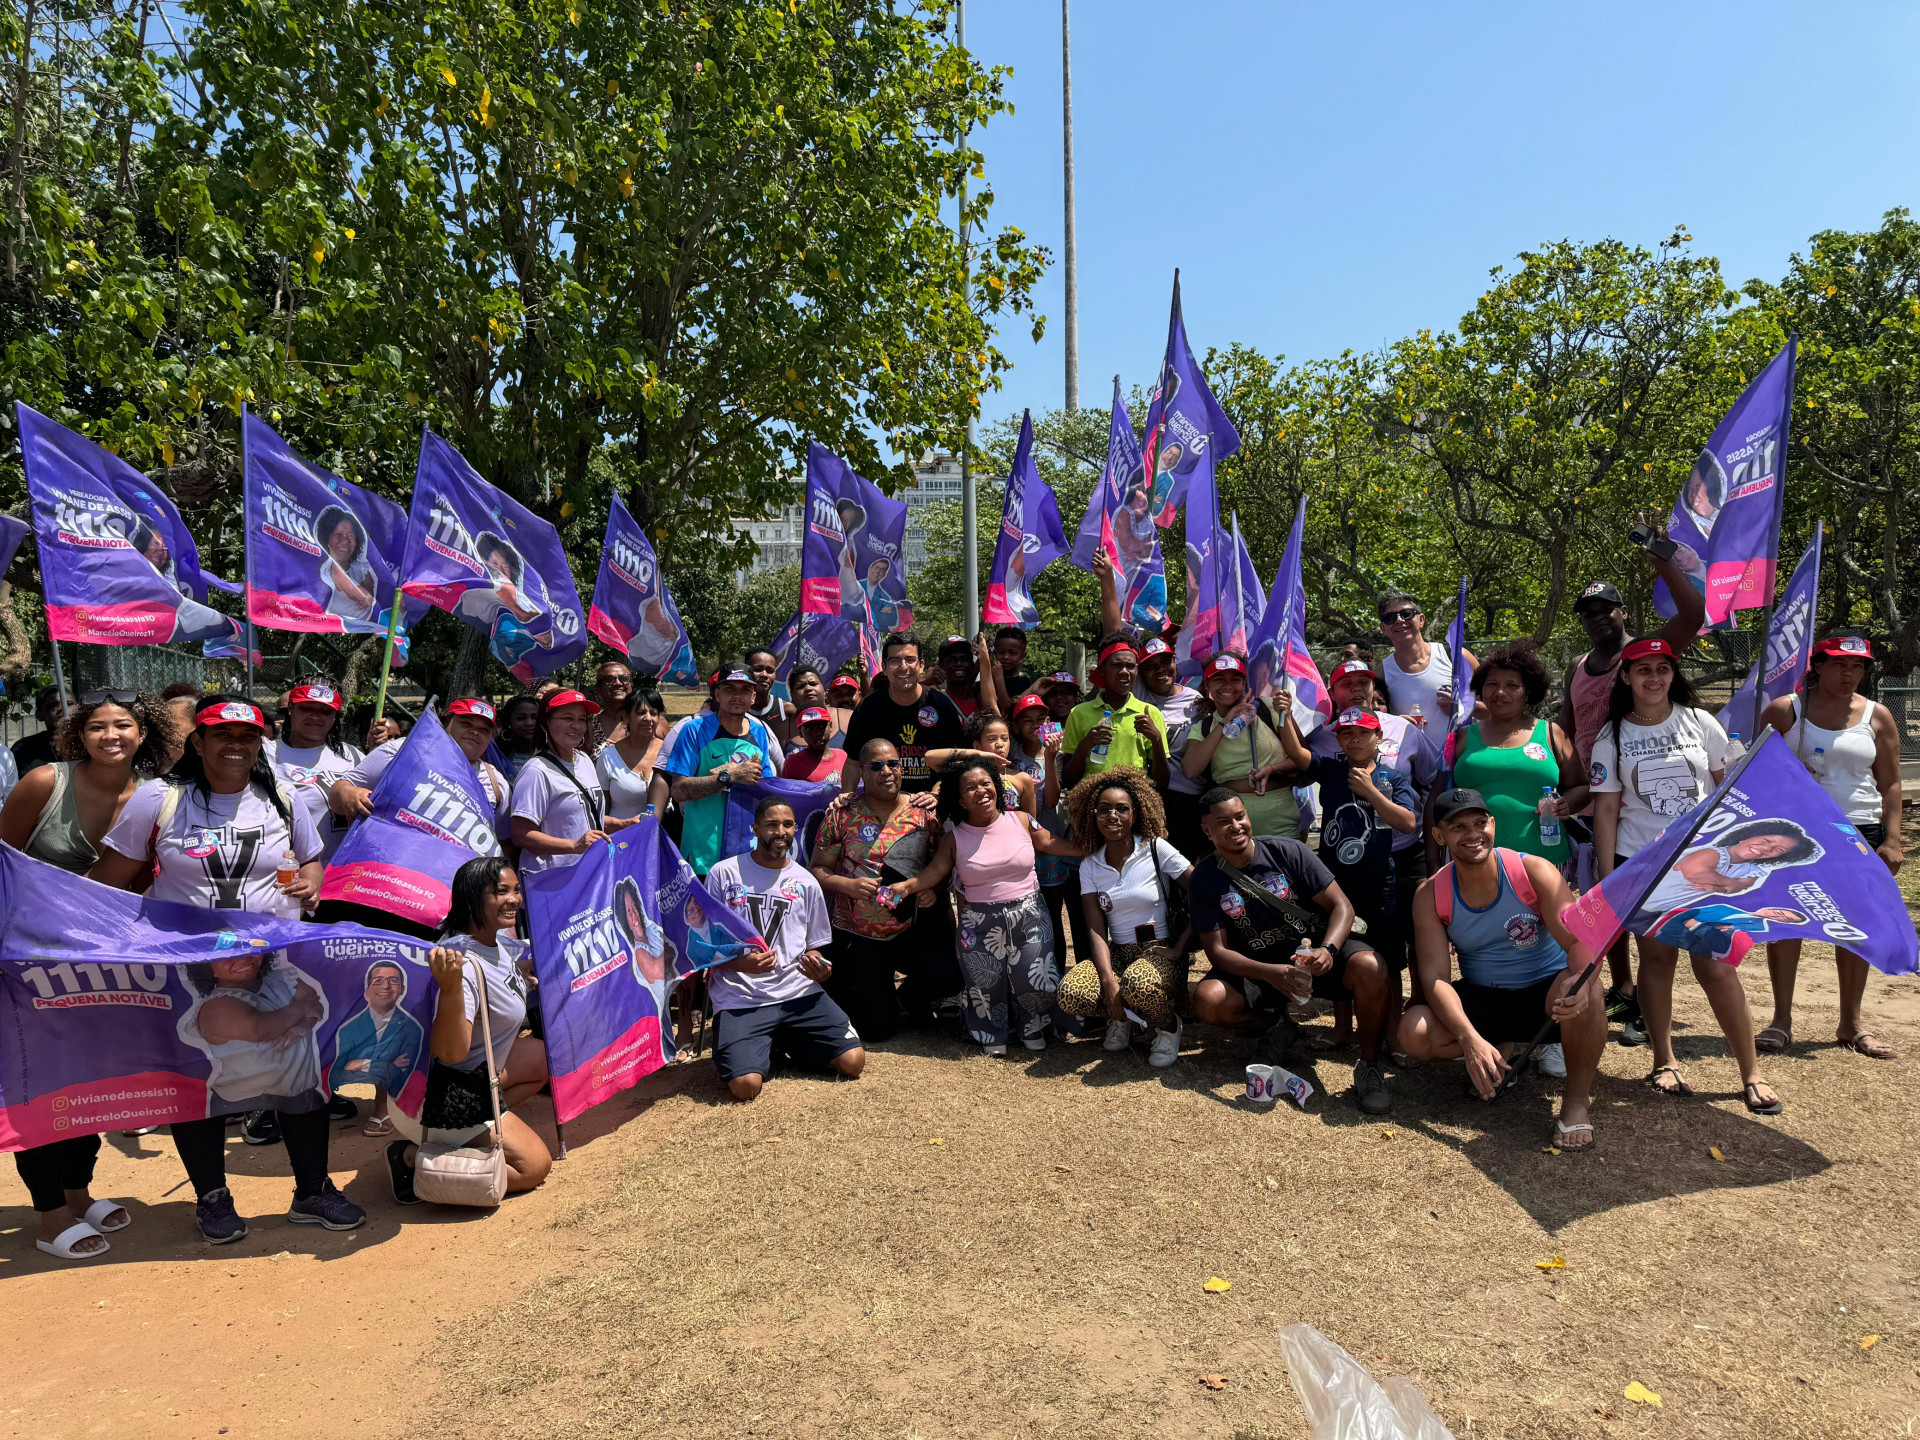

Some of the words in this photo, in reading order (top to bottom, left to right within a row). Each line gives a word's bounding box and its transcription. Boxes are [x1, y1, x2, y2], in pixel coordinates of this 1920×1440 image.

[1173, 410, 1200, 437] marcelo
[87, 502, 105, 512] DE
[106, 503, 132, 520] ASSIS
[263, 524, 293, 545] PEQUENA
[427, 769, 467, 802] VIVIANE
[397, 810, 440, 838] PEQUENA
[407, 782, 494, 854] 11110
[353, 884, 425, 911] MarceloQueiroz11
[362, 870, 435, 899] vivianedeassis10
[1802, 881, 1848, 923] marcelo
[582, 915, 595, 930] DE
[563, 919, 620, 978] 11110
[20, 962, 167, 999] 11110
[36, 994, 105, 1009] PEQUENA
[109, 992, 170, 1008] NOTÁVEL
[69, 1086, 178, 1107] vivianedeassis10
[71, 1105, 179, 1126] MarceloQueiroz11
